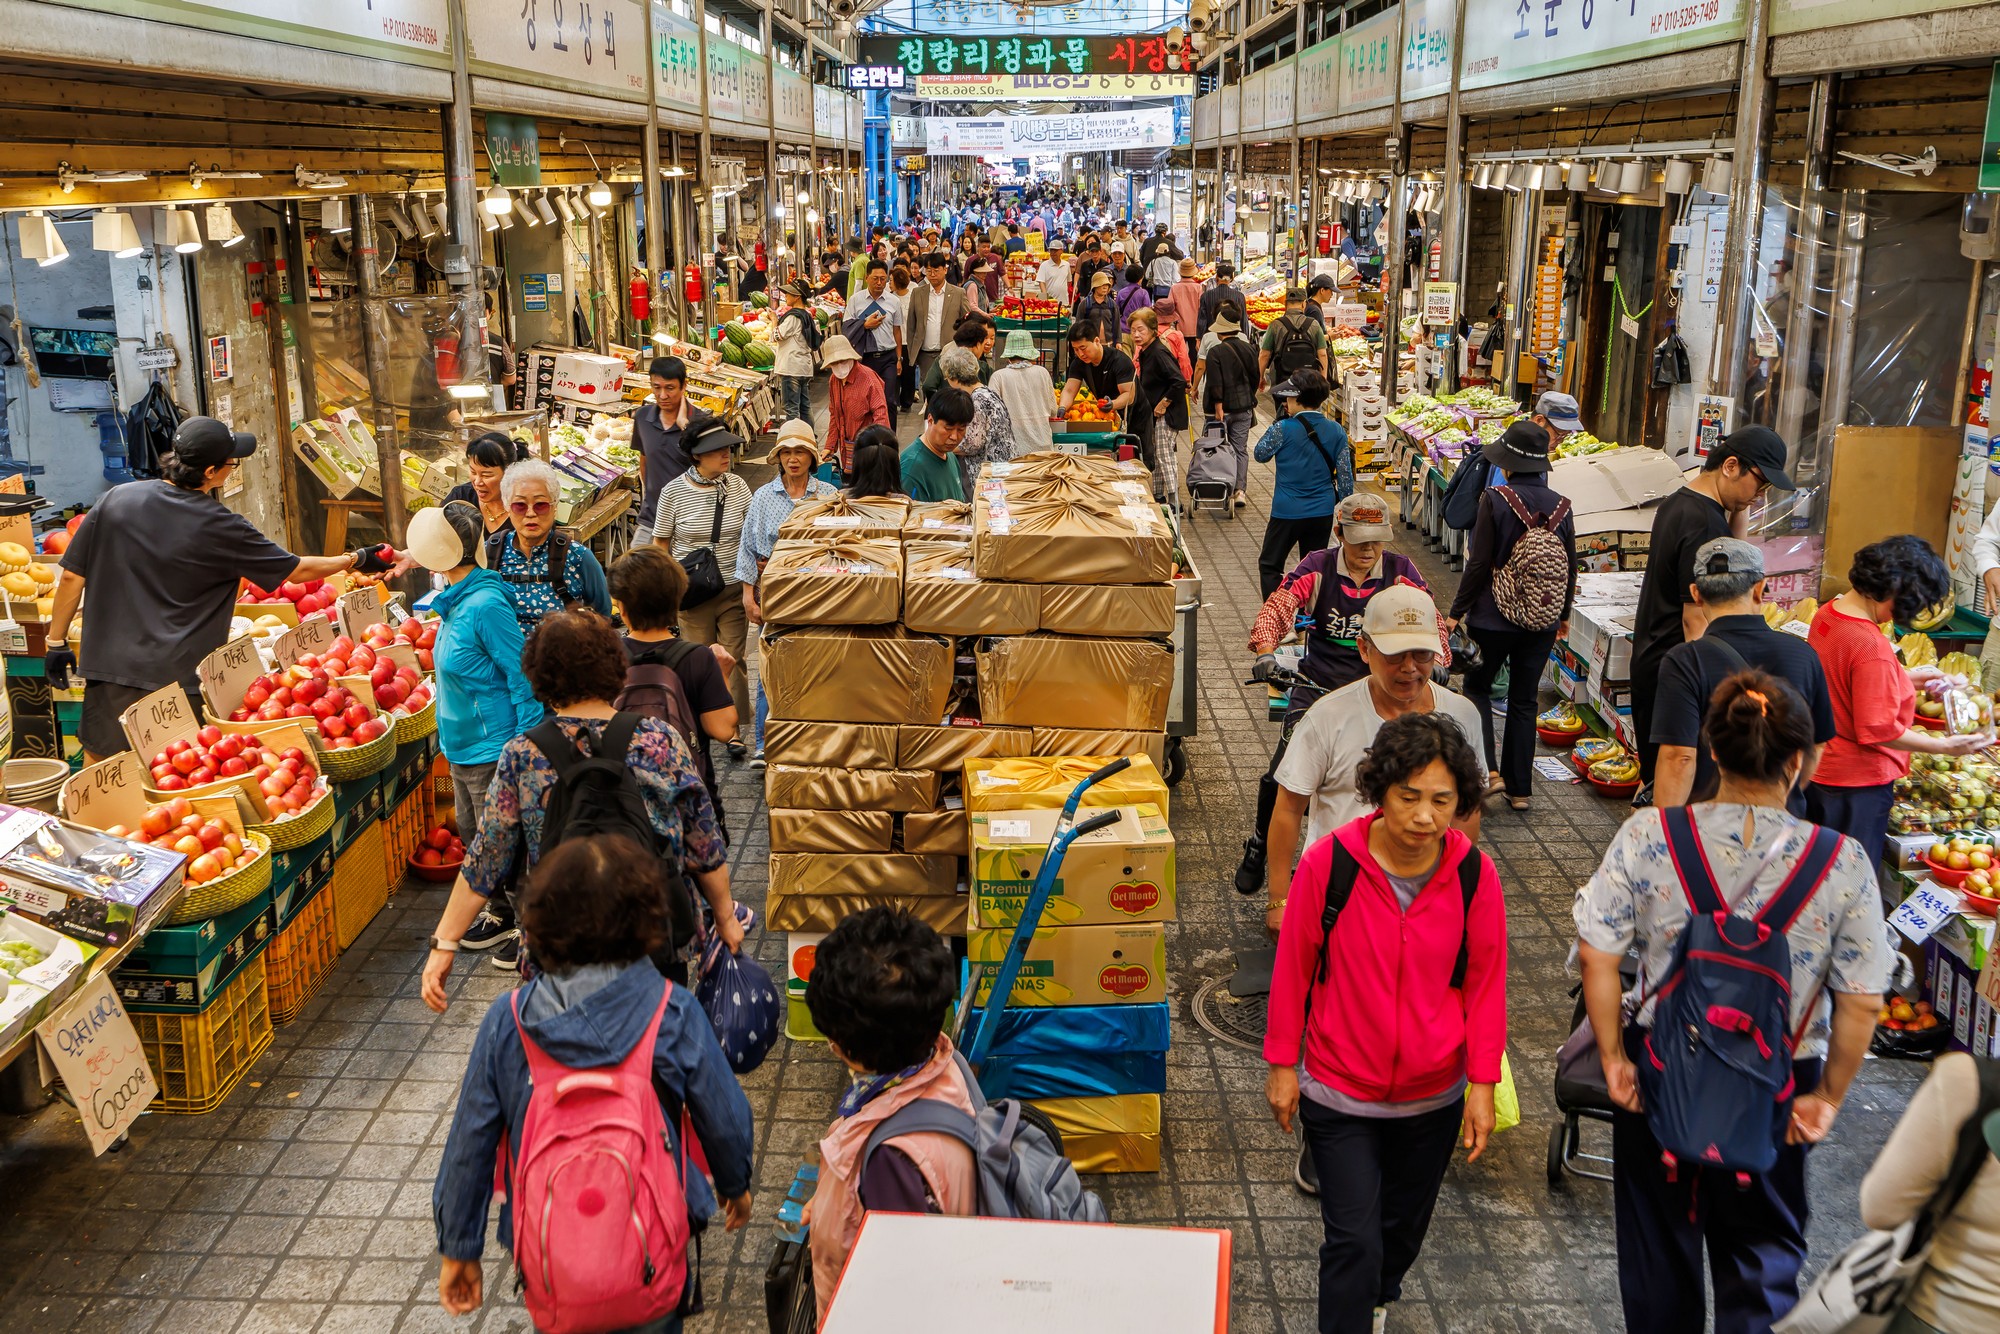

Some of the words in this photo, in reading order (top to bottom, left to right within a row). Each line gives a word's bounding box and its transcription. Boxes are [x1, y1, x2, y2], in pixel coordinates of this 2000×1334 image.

[1651, 14, 1662, 34] H.P
[1664, 0, 1719, 32] 010-5295-7489
[394, 20, 438, 46] 010-5389-0564
[659, 33, 697, 92] 삼동청과
[898, 38, 1089, 74] 청량리청과물
[492, 136, 512, 167] 강오
[522, 137, 538, 167] 상회
[1428, 295, 1451, 306] 환급행사
[1428, 306, 1450, 315] 참여점포
[557, 379, 577, 390] 사과
[351, 590, 374, 614] 만원
[296, 623, 323, 650] 만원
[223, 644, 249, 669] 만원
[151, 696, 182, 729] 만원
[70, 777, 90, 815] 5개
[95, 760, 126, 794] 만원
[24, 891, 49, 909] 포도
[981, 883, 1031, 894] Premiu
[1113, 892, 1127, 901] Del
[1129, 891, 1157, 902] Monte
[981, 899, 1055, 911] BANAS
[175, 981, 194, 1001] 梨
[1102, 974, 1117, 985] Del
[1118, 973, 1147, 985] Monte
